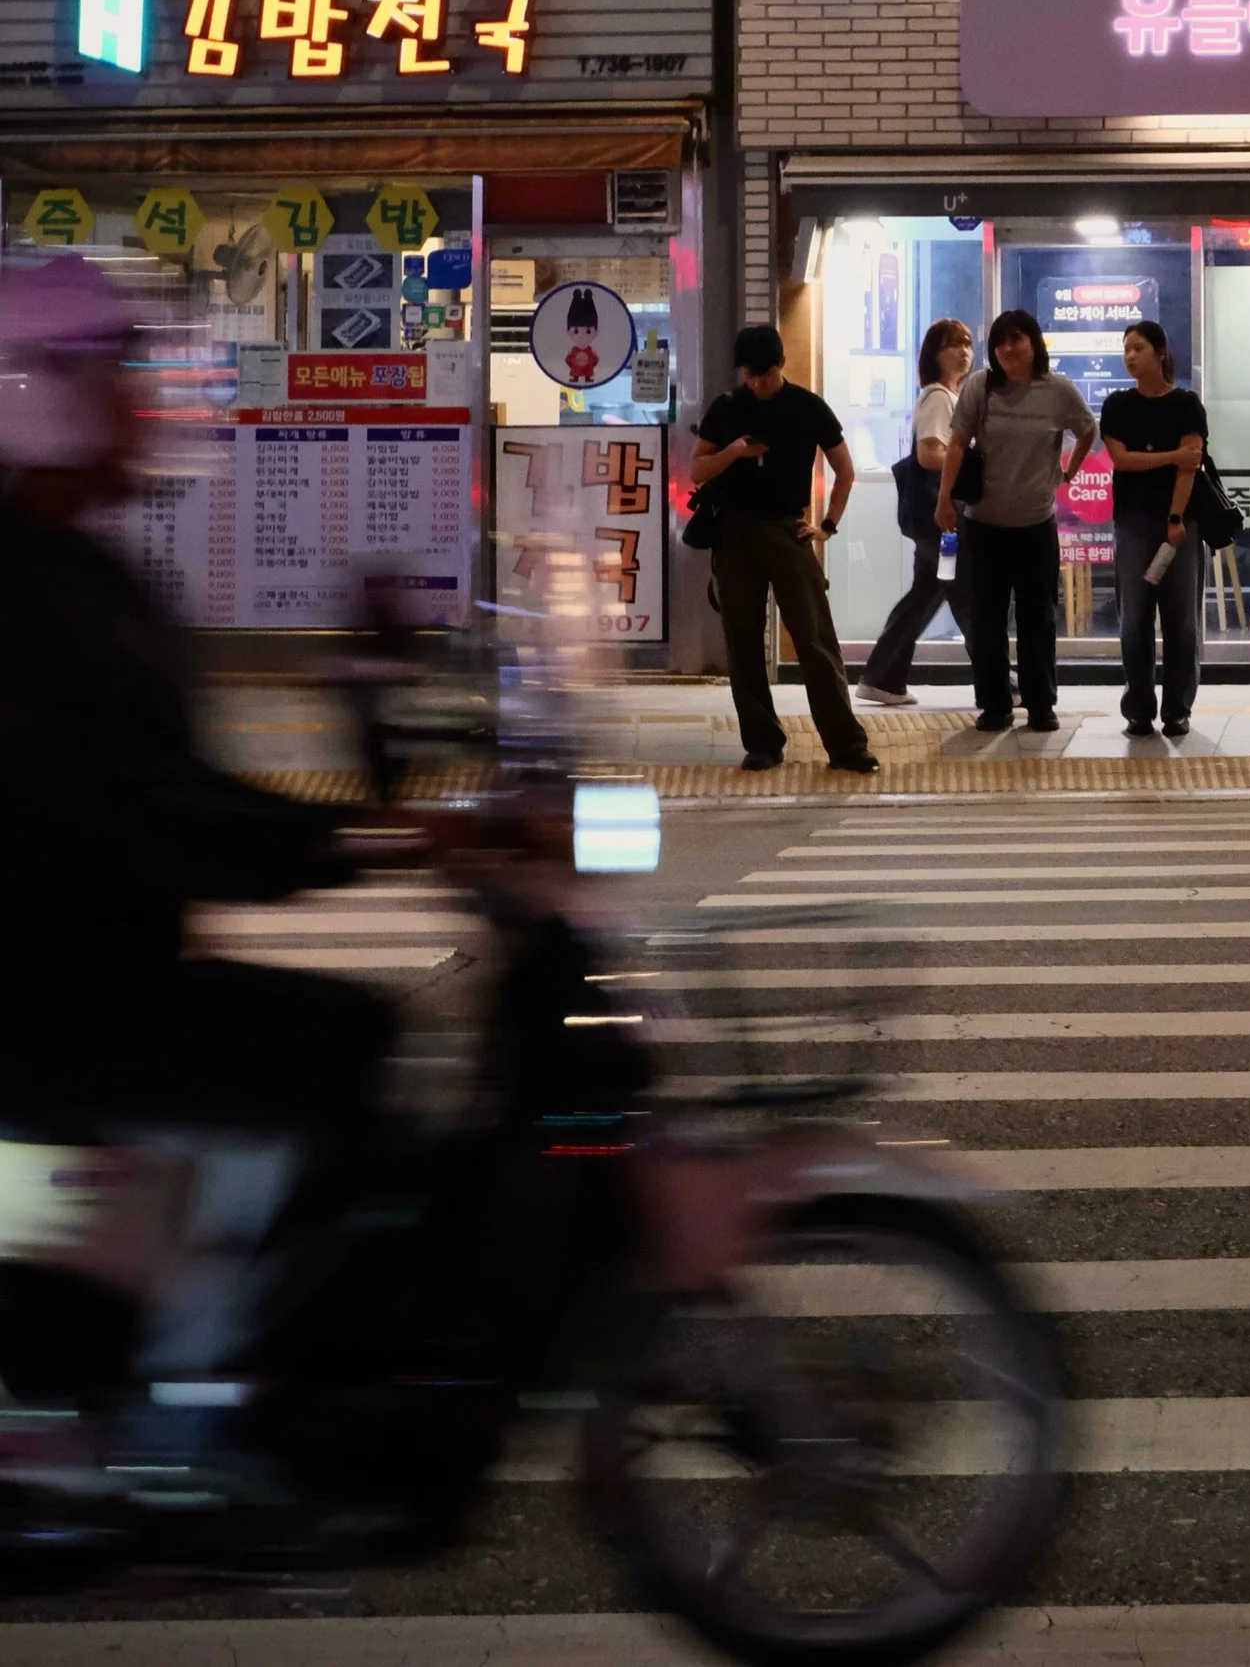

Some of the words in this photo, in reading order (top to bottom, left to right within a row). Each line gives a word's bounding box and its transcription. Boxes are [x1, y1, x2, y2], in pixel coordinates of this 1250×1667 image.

[1054, 306, 1077, 320] 보안
[1106, 305, 1143, 321] 서비스
[294, 365, 367, 389] 모든메뉴
[1068, 486, 1108, 501] Care
[1087, 546, 1114, 562] 환영
